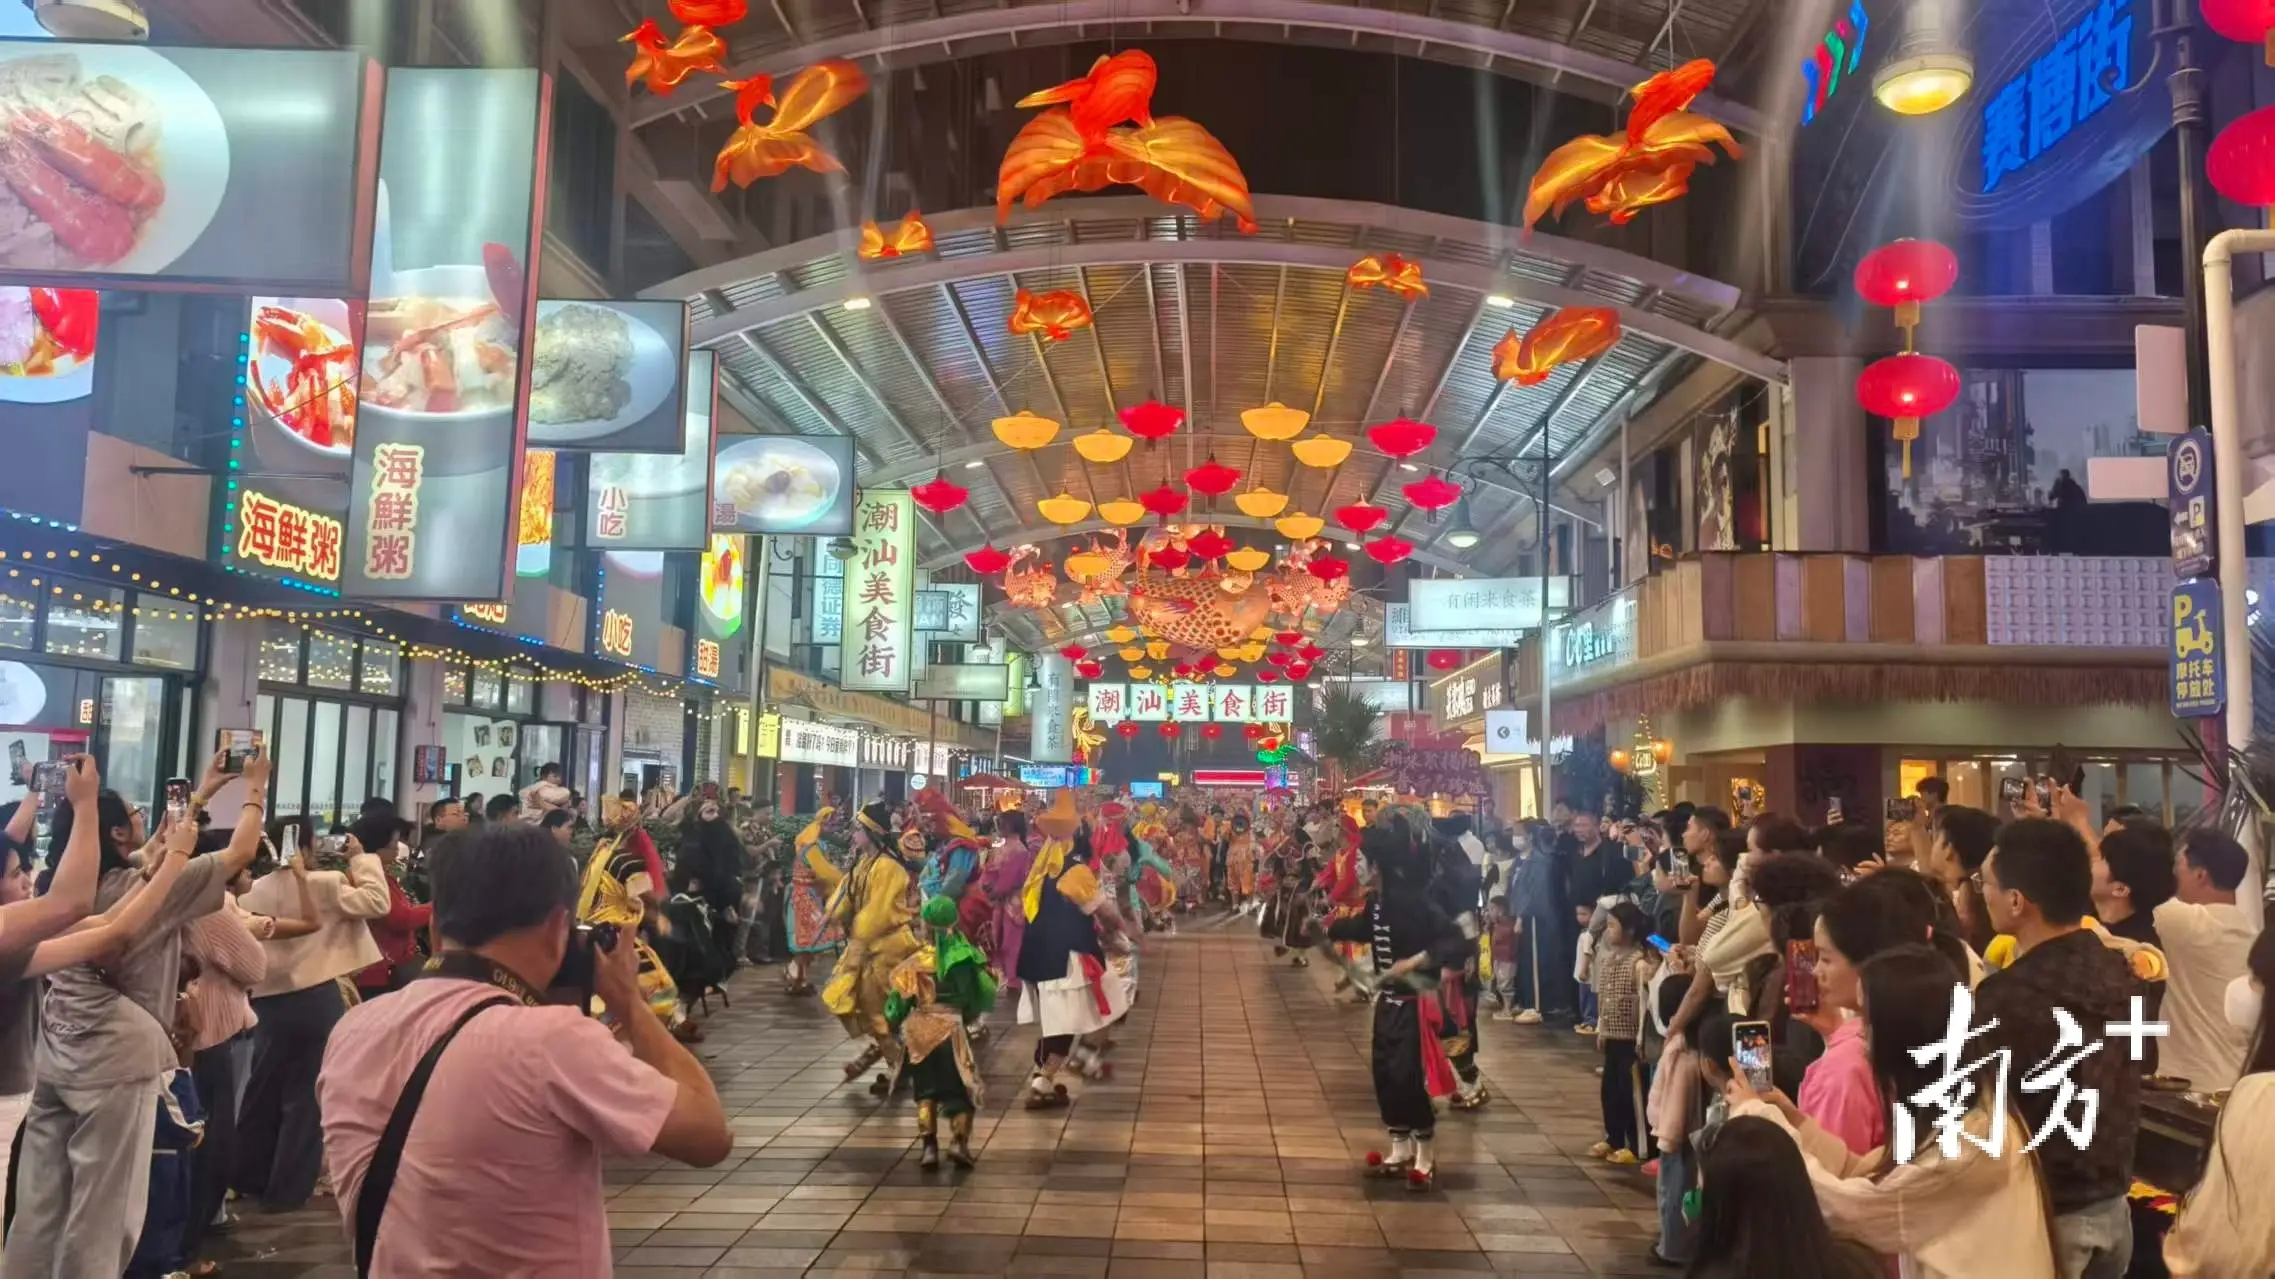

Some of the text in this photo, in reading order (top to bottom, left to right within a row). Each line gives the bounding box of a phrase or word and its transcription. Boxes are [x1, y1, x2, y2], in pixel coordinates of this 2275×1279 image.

[367, 446, 421, 576] 海鮮粥
[599, 485, 627, 537] 小吃
[241, 492, 341, 577] 海鮮粥
[856, 501, 898, 679] 潮汕美食街
[2174, 594, 2193, 627] P
[603, 610, 632, 654] 小吃
[2175, 657, 2215, 681] 摩托车
[2175, 678, 2215, 699] 停放处
[1095, 688, 1288, 719] 潮汕美食街
